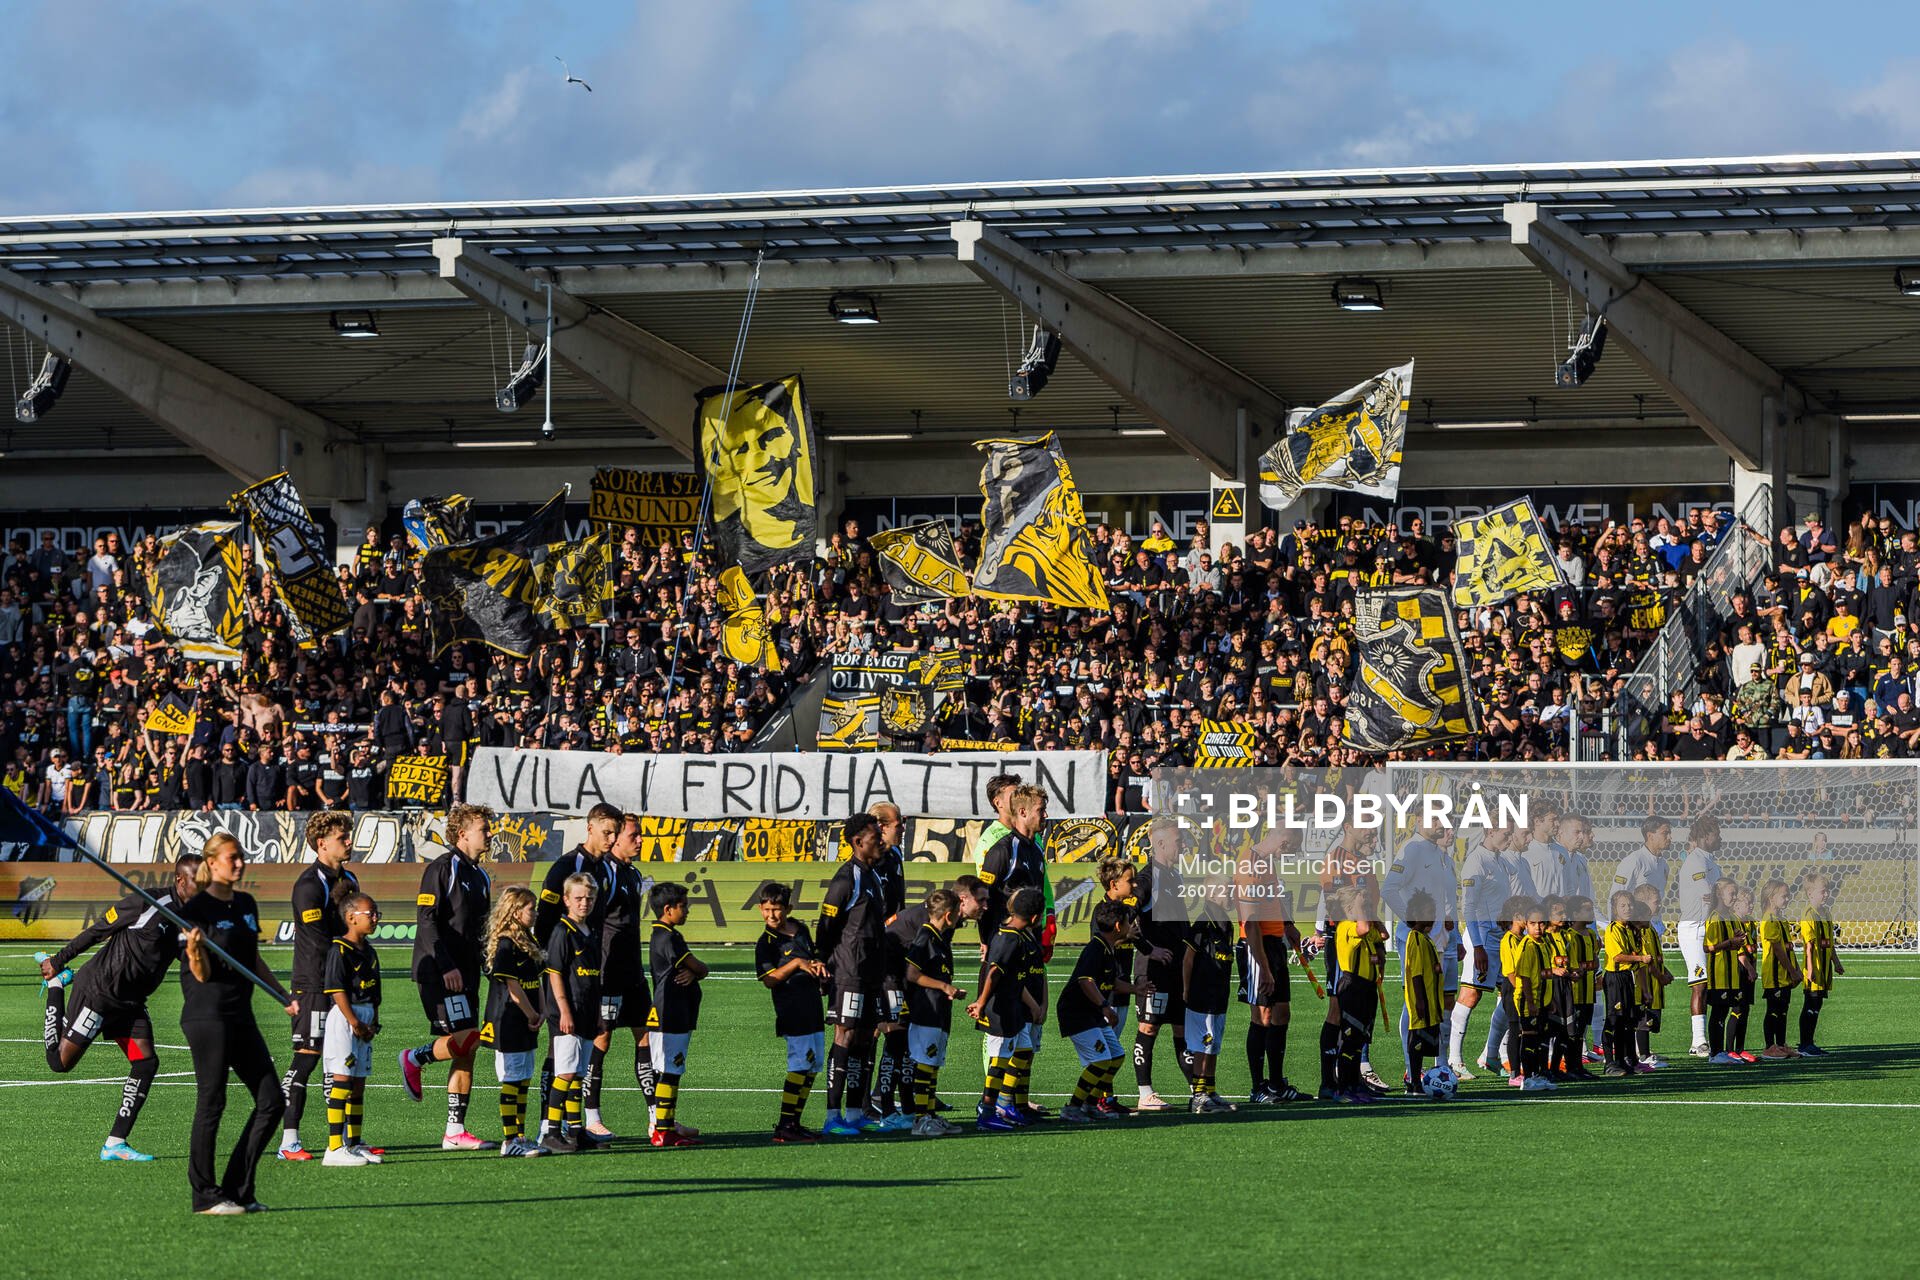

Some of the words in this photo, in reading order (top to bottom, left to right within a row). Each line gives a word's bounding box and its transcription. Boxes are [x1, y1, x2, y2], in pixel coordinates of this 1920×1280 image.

[832, 651, 860, 667] FÖR
[864, 653, 908, 669] EVIGT
[164, 703, 188, 725] STO
[1206, 745, 1221, 757] ON
[1219, 745, 1247, 758] TOUR
[494, 754, 605, 810] VILA
[641, 759, 651, 811] I
[683, 759, 810, 815] FRID,
